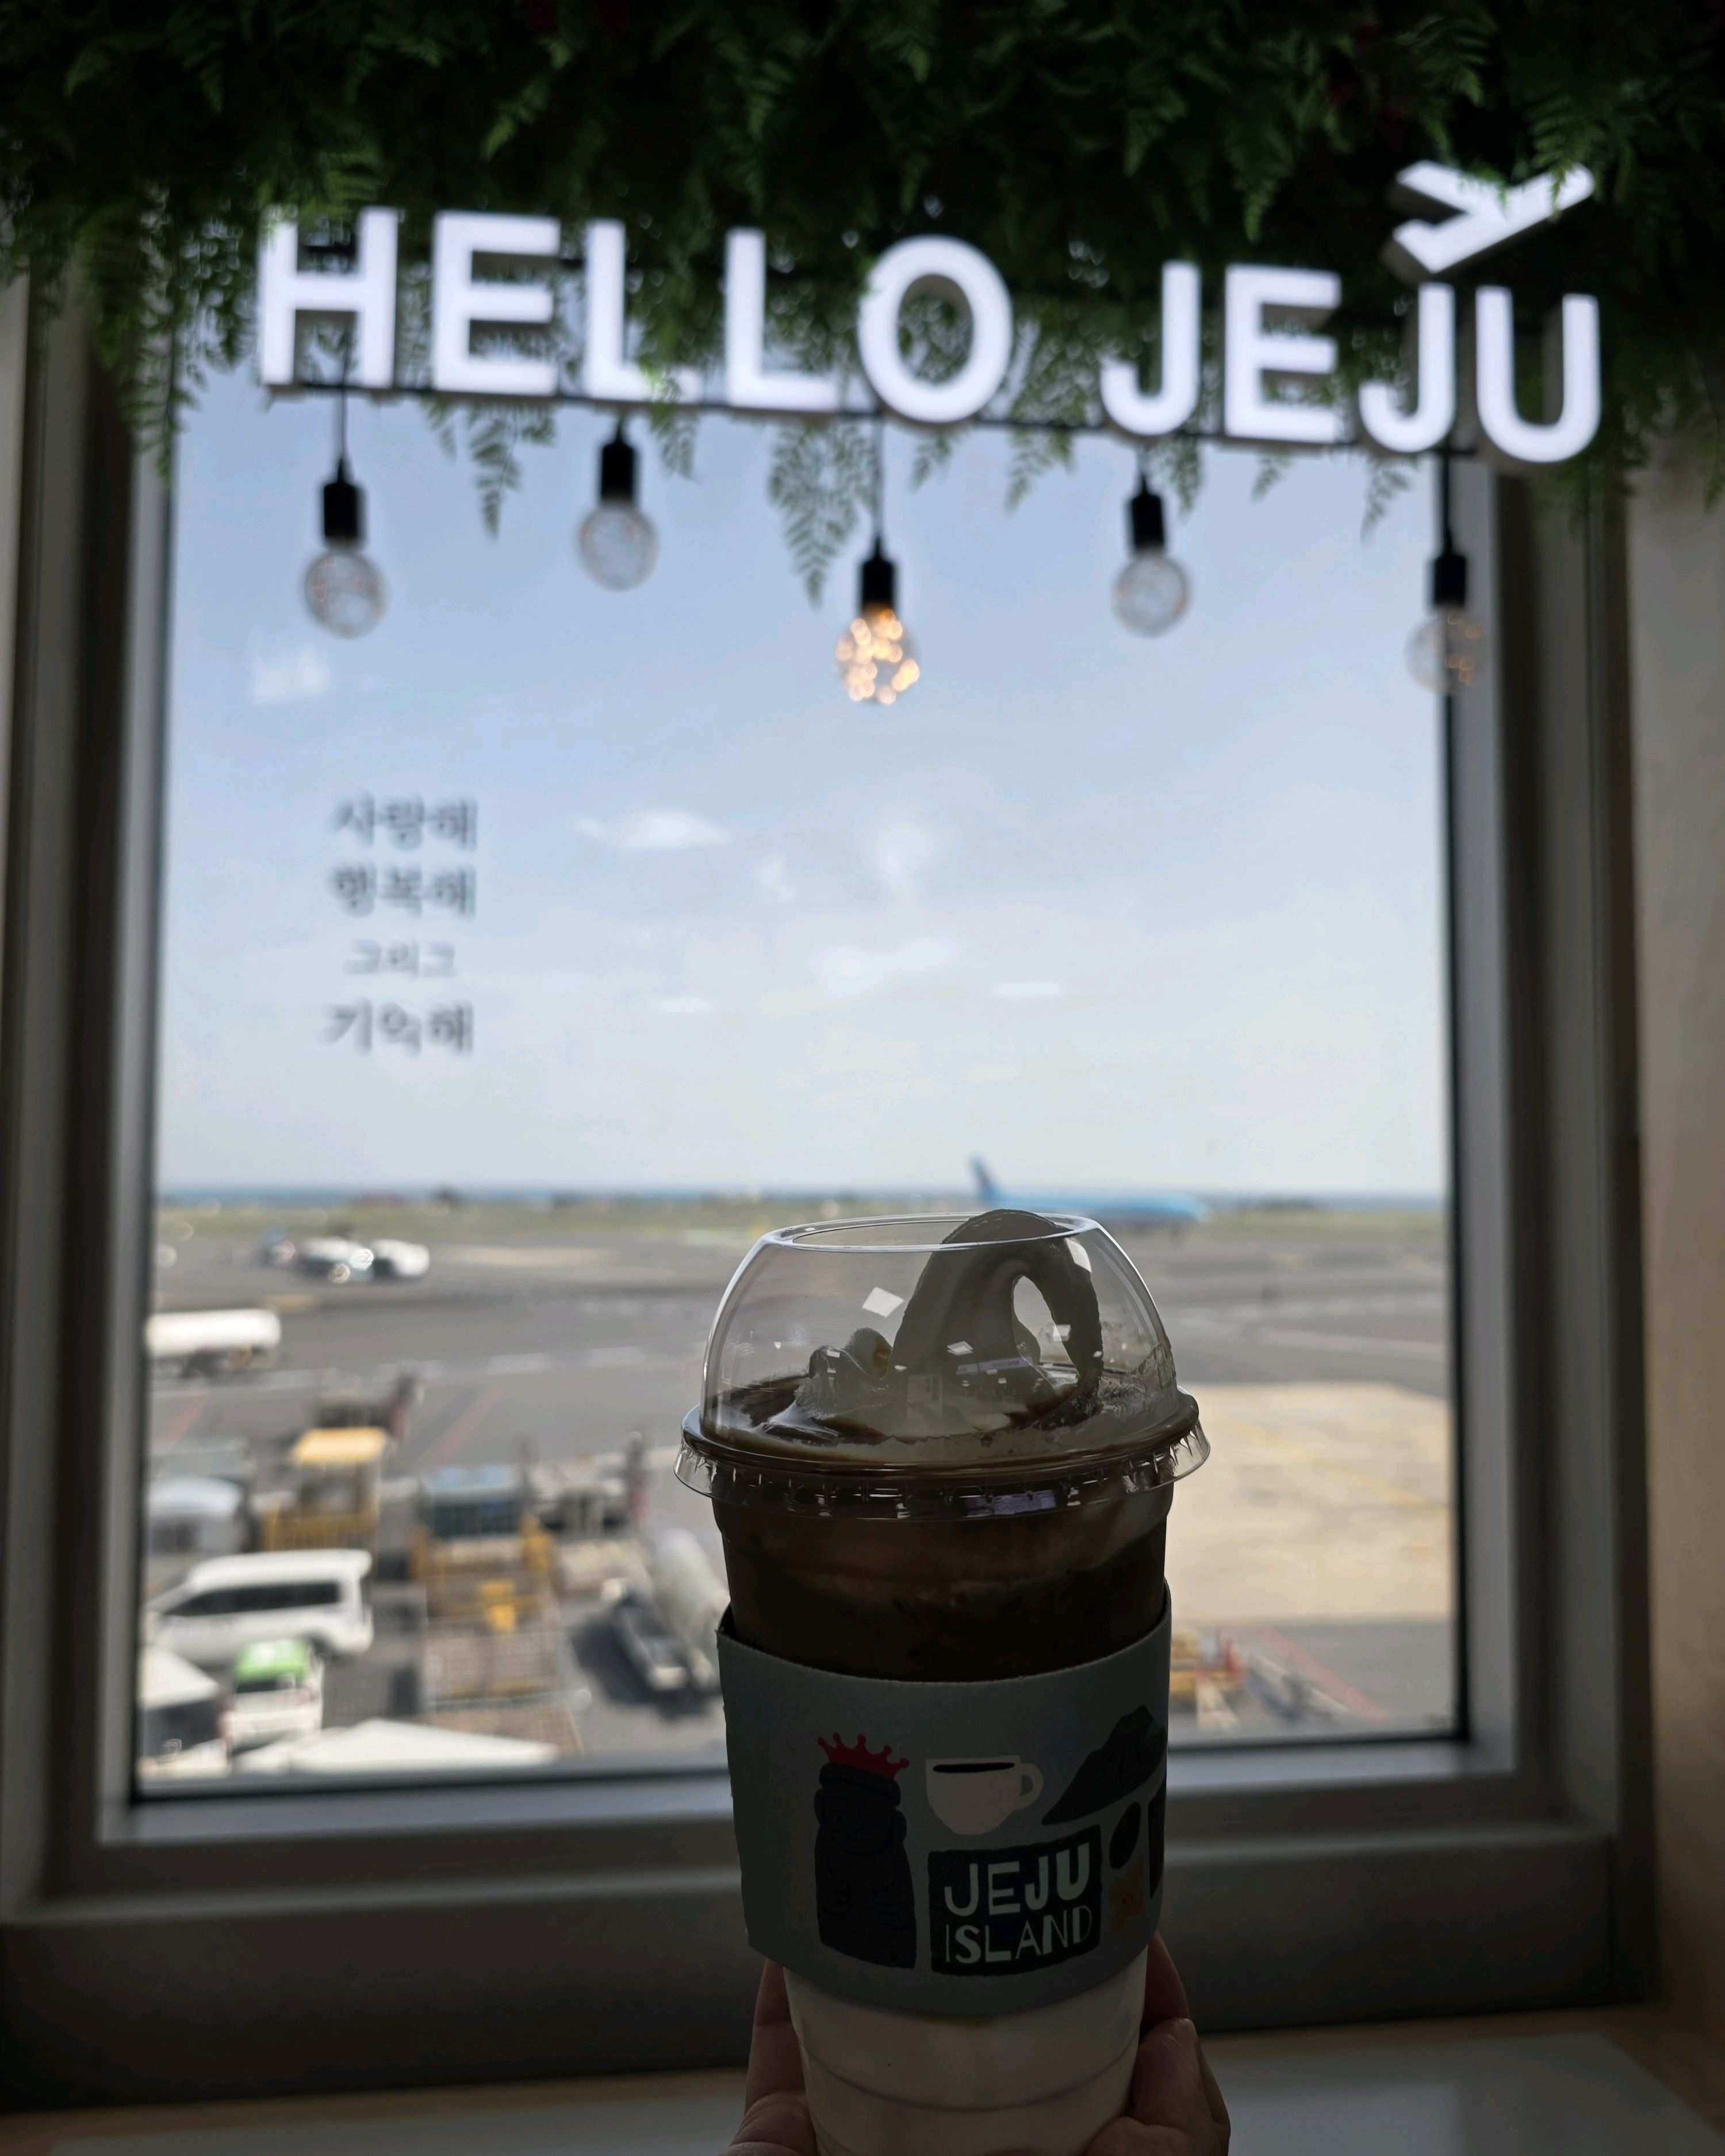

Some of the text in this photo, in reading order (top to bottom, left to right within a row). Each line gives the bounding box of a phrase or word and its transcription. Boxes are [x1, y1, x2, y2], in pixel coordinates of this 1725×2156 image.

[258, 206, 1601, 461] HELLO JEJU
[325, 792, 477, 851] 사랑해
[327, 862, 476, 918] 행복해
[320, 999, 474, 1057] 기억해
[944, 1842, 1090, 1916] JEJU
[946, 1905, 1092, 1963] ISLAND
